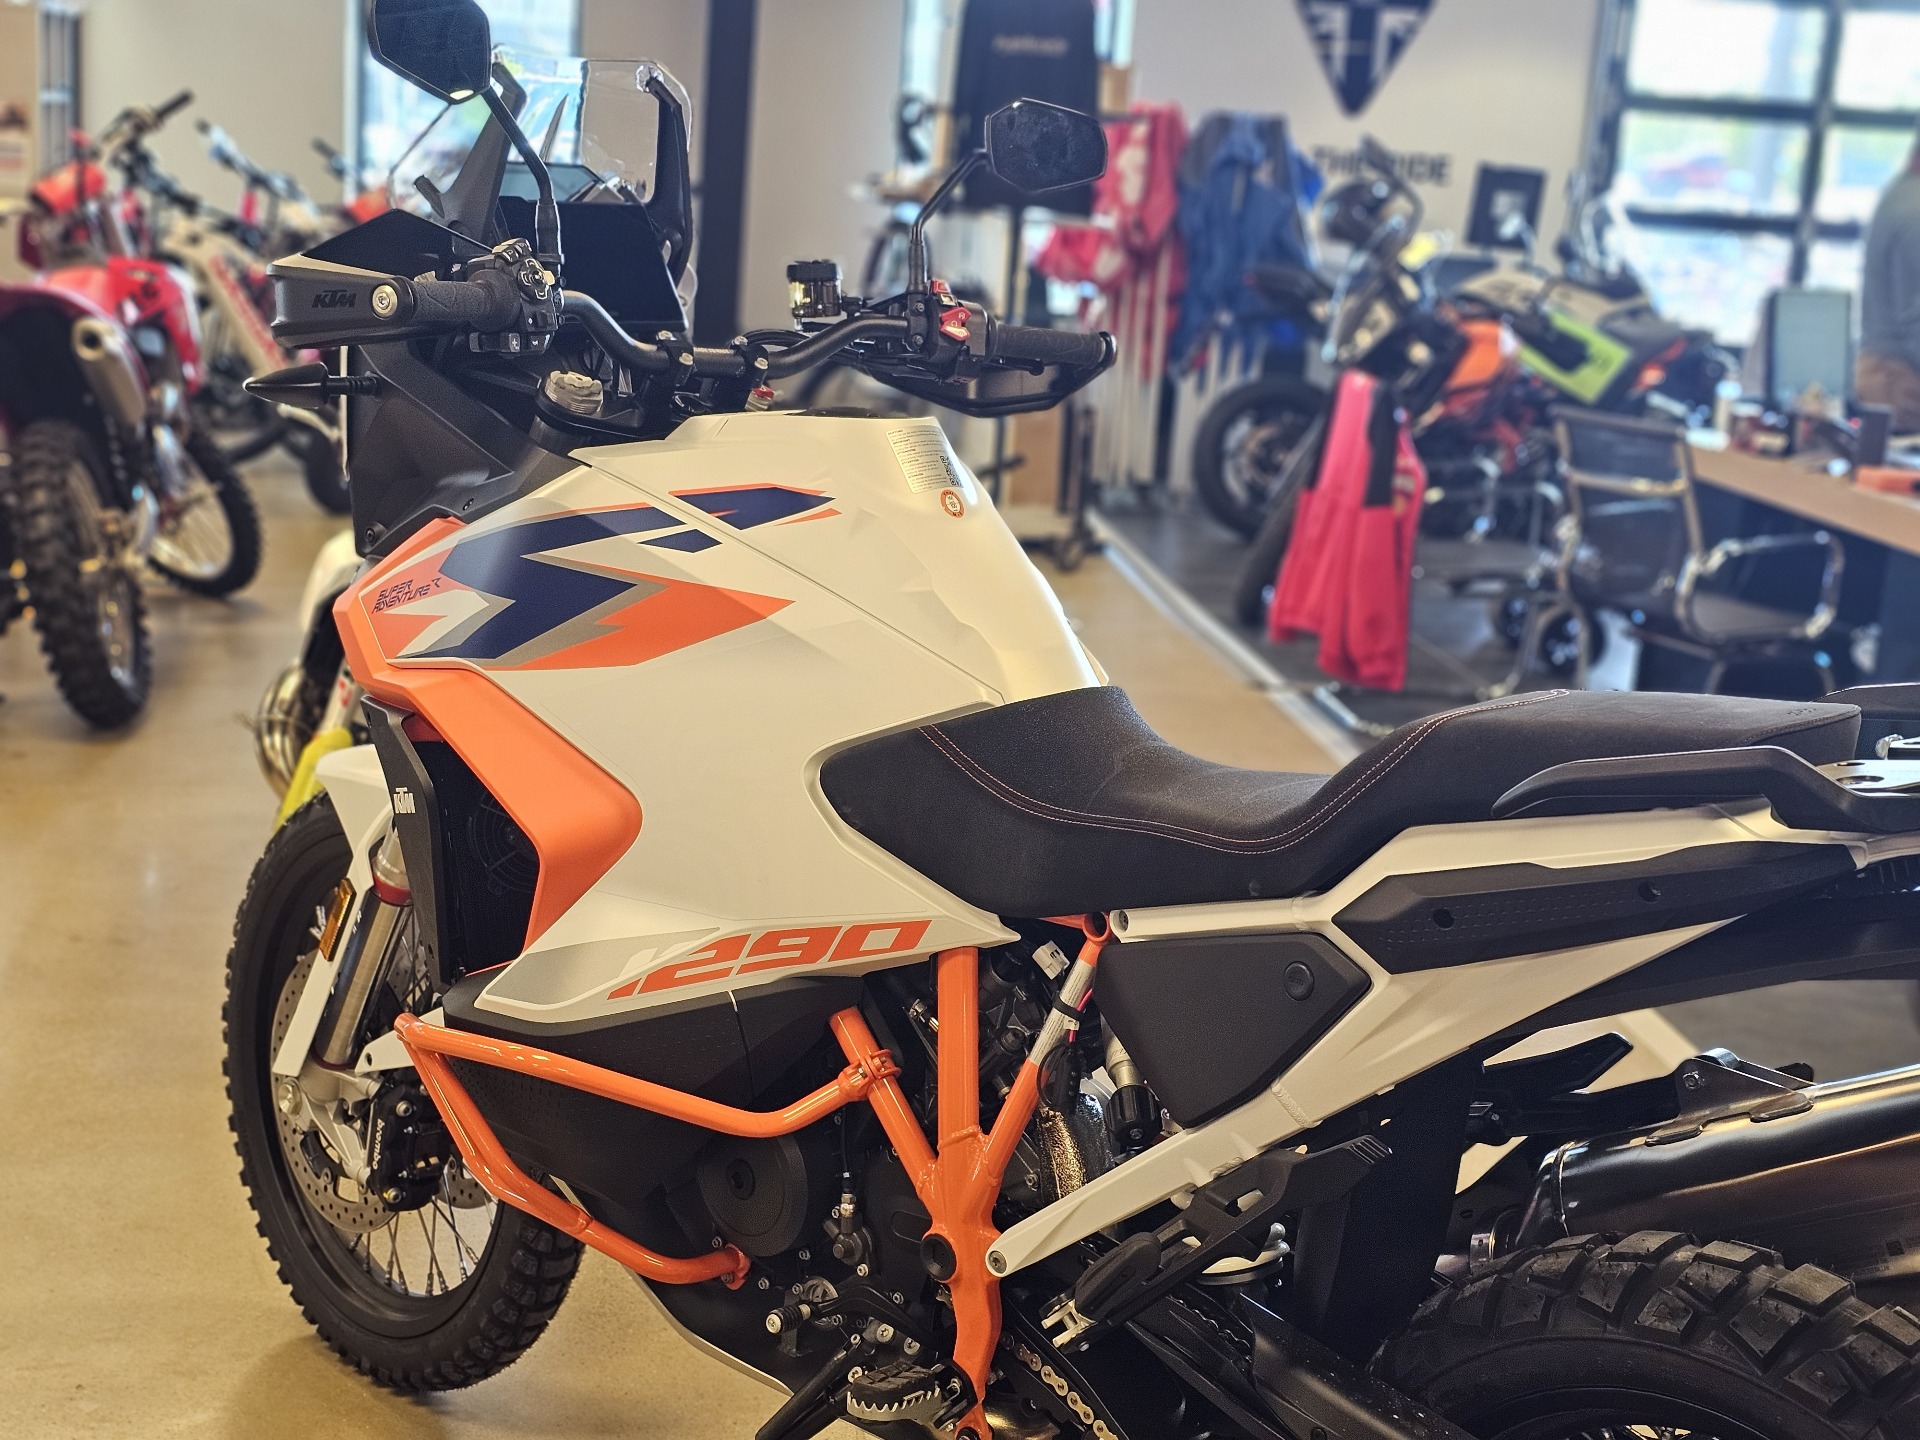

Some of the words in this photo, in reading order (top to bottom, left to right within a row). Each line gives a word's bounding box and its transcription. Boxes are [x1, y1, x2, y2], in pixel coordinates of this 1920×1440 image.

[312, 289, 357, 308] KTM
[371, 584, 431, 614] ADVENTURE
[376, 579, 414, 602] SUPER
[393, 787, 416, 814] KTM
[372, 1118, 385, 1170] brembo
